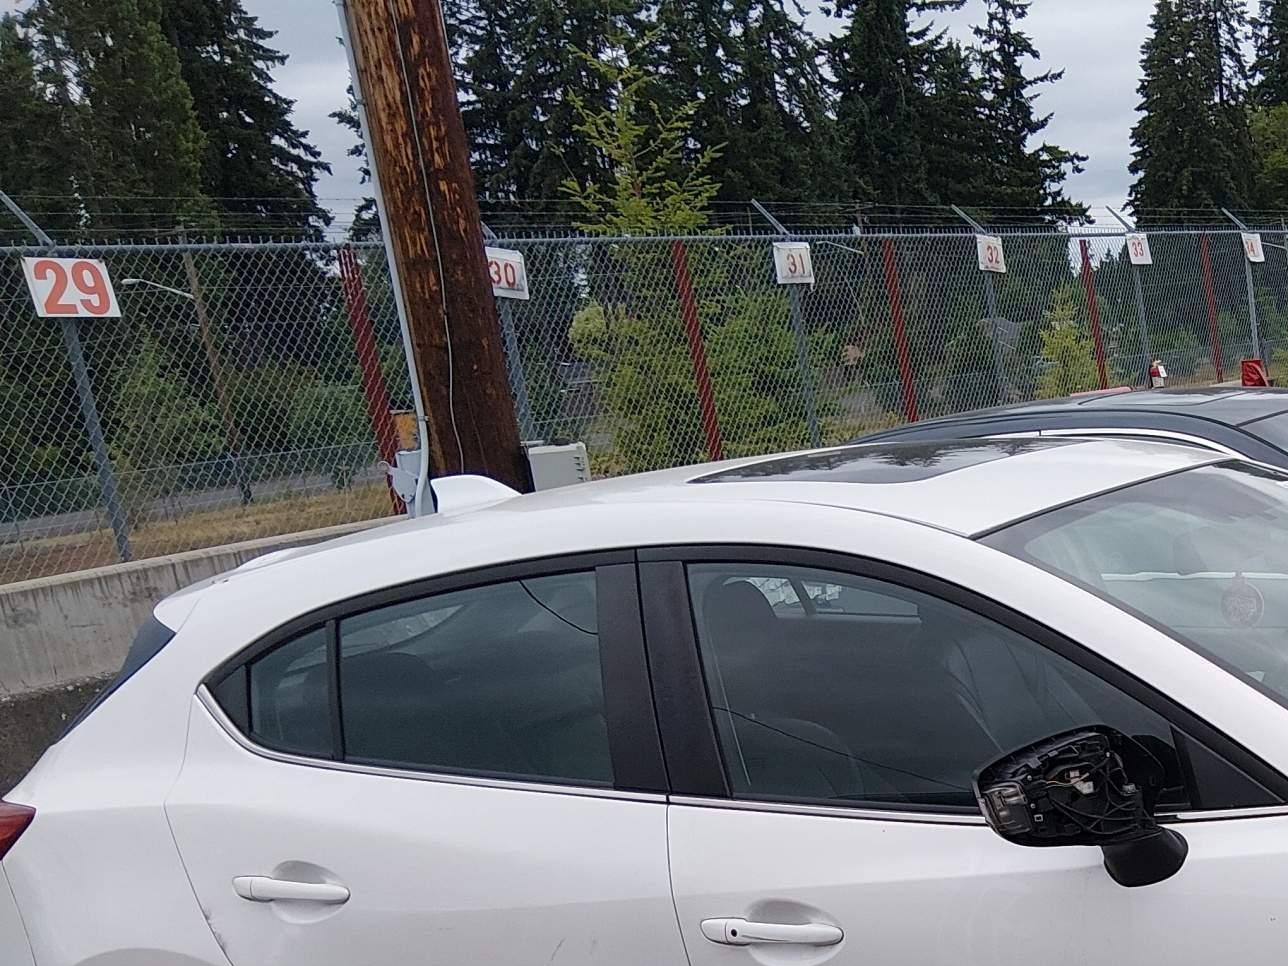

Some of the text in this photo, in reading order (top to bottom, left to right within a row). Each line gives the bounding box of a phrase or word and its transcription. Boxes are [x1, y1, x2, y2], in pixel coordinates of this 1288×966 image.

[987, 245, 1001, 264] 32
[1131, 241, 1145, 257] 33
[488, 260, 516, 288] 30
[787, 253, 805, 274] 31
[33, 259, 111, 315] 29
